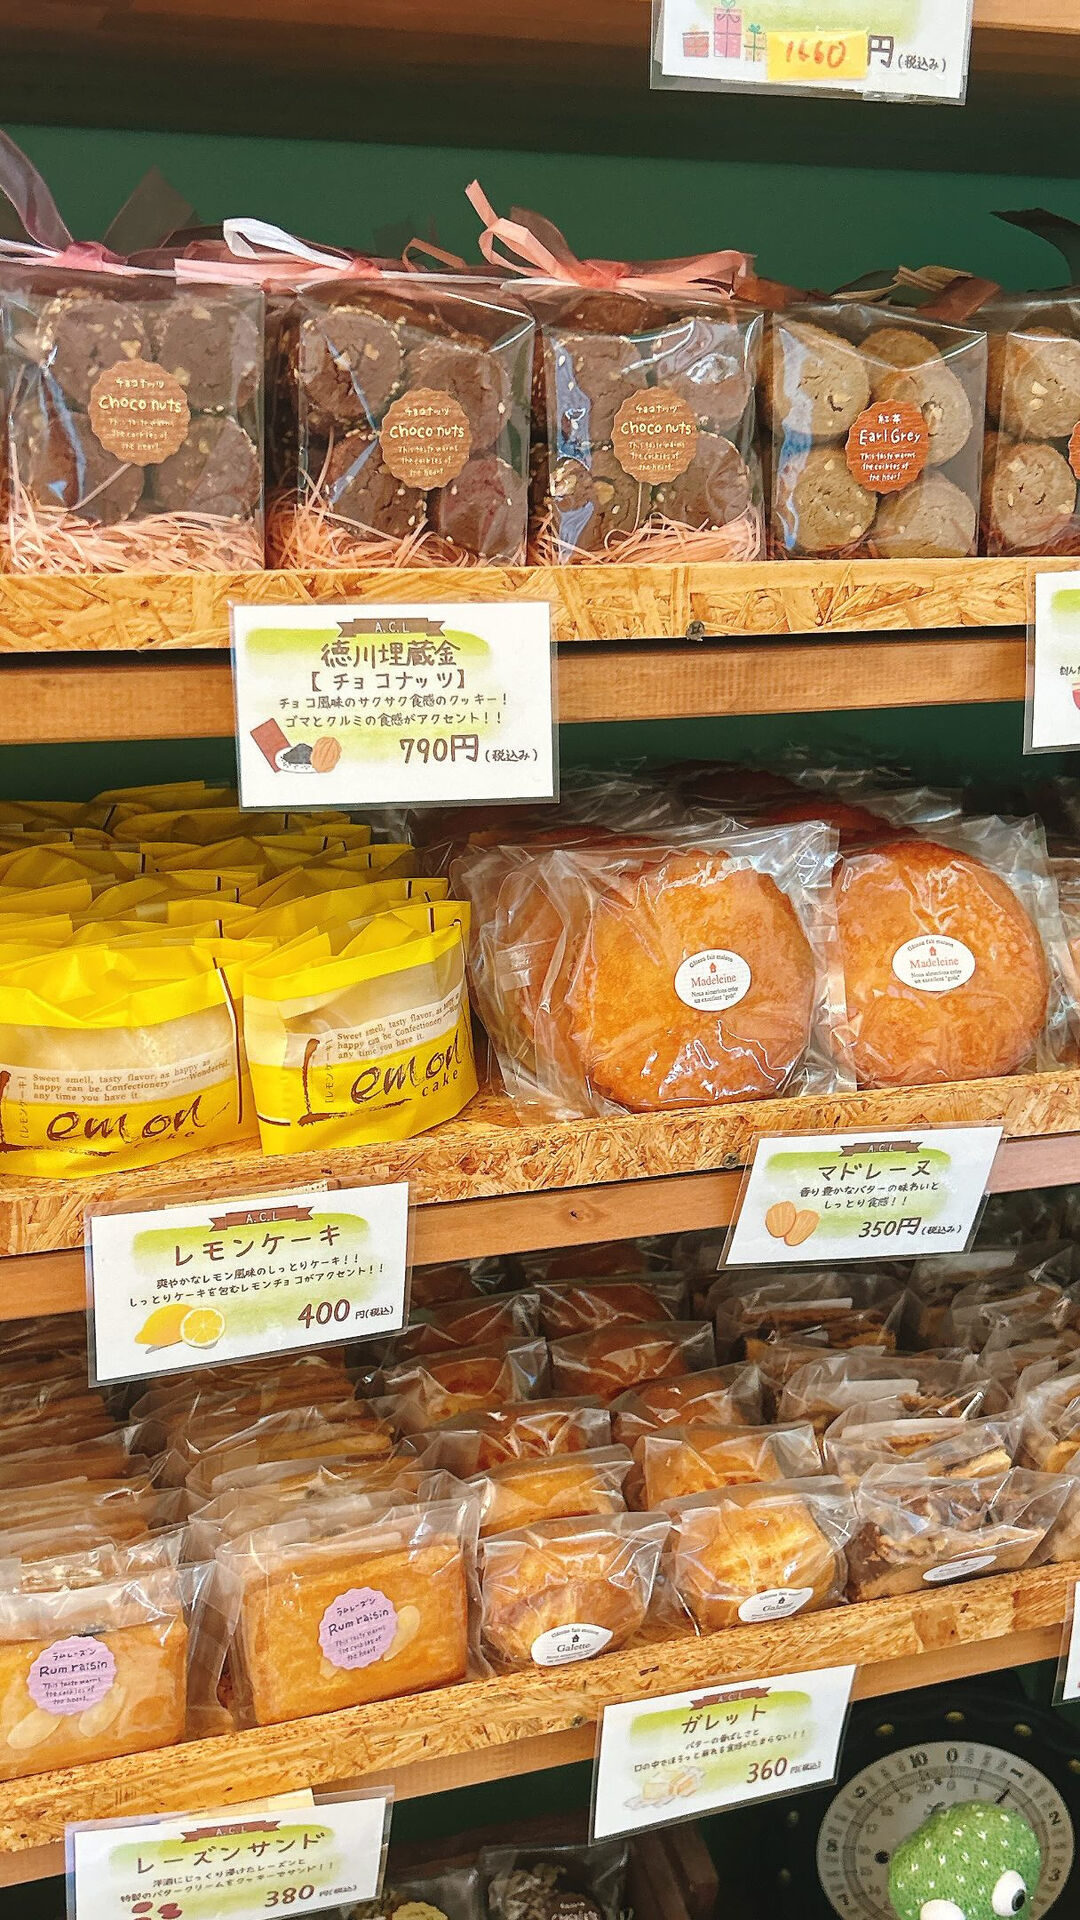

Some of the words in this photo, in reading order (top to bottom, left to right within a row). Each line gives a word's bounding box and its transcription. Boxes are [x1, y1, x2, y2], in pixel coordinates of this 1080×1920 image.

[786, 40, 846, 68] 1660
[867, 35, 895, 68] 円
[98, 393, 147, 412] Choco
[151, 398, 182, 413] nuts
[390, 424, 433, 439] Choco
[437, 424, 465, 438] nuts
[621, 421, 662, 435] Choco
[665, 421, 692, 435] nuts
[859, 429, 887, 445] Earl
[890, 427, 921, 443] Grey
[320, 640, 461, 668] 徳川埋蔵金
[310, 669, 465, 692] 【チョコナッツ】
[279, 693, 508, 710] チョコ風味のサクサク食感のクッキー！
[285, 712, 502, 728] ゴマとクルミの食感がアクセント！！
[400, 733, 479, 764] 790円
[909, 957, 959, 969] Madeleine
[691, 974, 736, 988] Madeleine
[337, 1032, 362, 1040] Sweet
[388, 1018, 407, 1028] tasty
[337, 1041, 364, 1050] happy
[368, 1037, 380, 1046] can
[338, 1051, 354, 1059] any
[396, 1036, 413, 1047] have
[33, 1073, 60, 1083] Sweet
[99, 1076, 122, 1084] tasty
[174, 1063, 199, 1075] happy
[422, 1069, 458, 1097] cake
[33, 1083, 61, 1092] happy
[105, 1080, 170, 1092] Confectionery
[818, 1160, 932, 1181] マドレーヌ
[800, 1181, 939, 1198] 香り豊かなバターの味わいと
[824, 1197, 907, 1209] しっとり食感！！
[859, 1216, 922, 1239] 350円
[174, 1224, 342, 1267] レモンケーキ
[156, 1254, 359, 1290] 爽やかなレモン風味のしっとりケーキ！！
[298, 1298, 351, 1329] 400
[328, 1620, 354, 1636] Rum
[356, 1609, 389, 1625] raisin
[53, 1648, 97, 1661] ラムレーズン
[557, 1643, 591, 1652] Galette
[40, 1666, 68, 1677] Rum
[71, 1661, 108, 1672] raisin
[681, 1704, 767, 1734] ガレット
[946, 1748, 958, 1762] 0
[746, 1757, 788, 1784] 360
[1049, 1810, 1061, 1826] 2
[137, 1832, 326, 1875] レーズンサンド
[264, 1884, 315, 1908] 380
